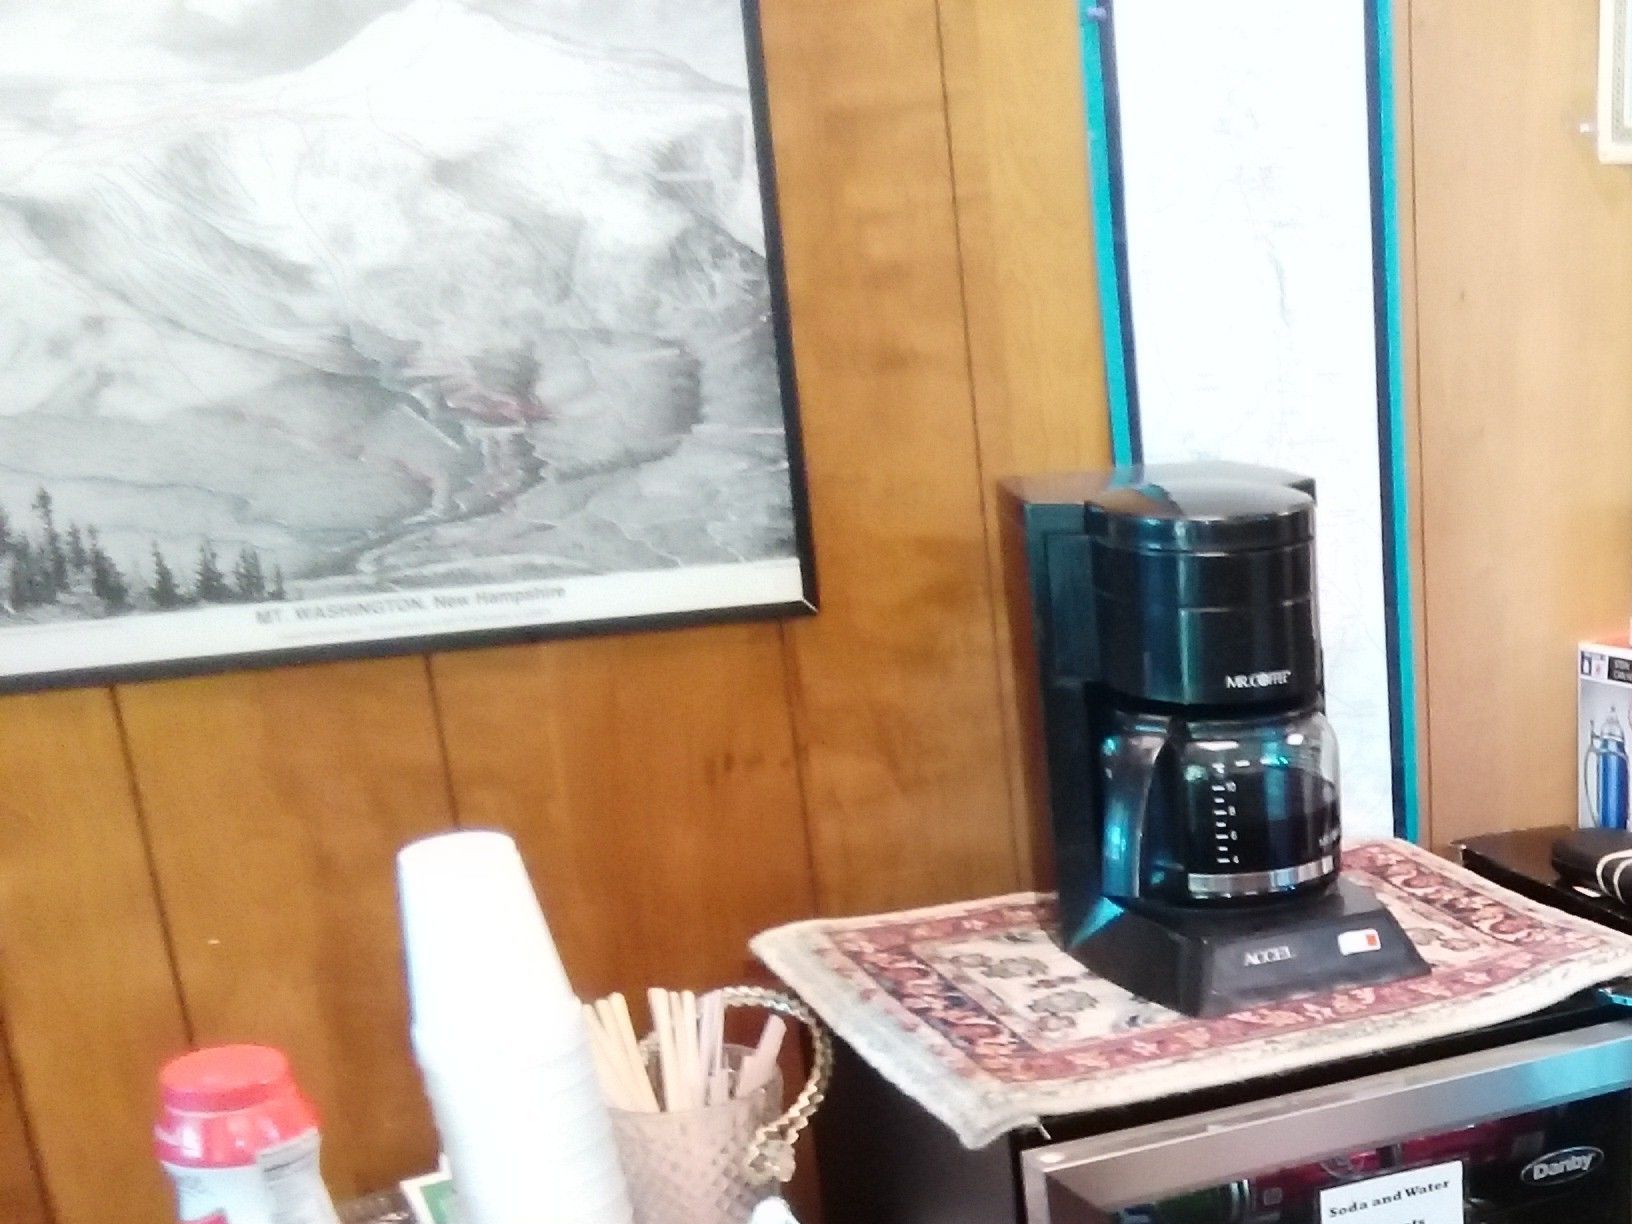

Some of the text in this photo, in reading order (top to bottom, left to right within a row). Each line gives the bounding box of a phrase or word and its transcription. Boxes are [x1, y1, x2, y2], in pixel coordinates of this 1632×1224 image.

[1532, 1153, 1595, 1181] Danby
[1329, 1179, 1450, 1218] Soda and Water
